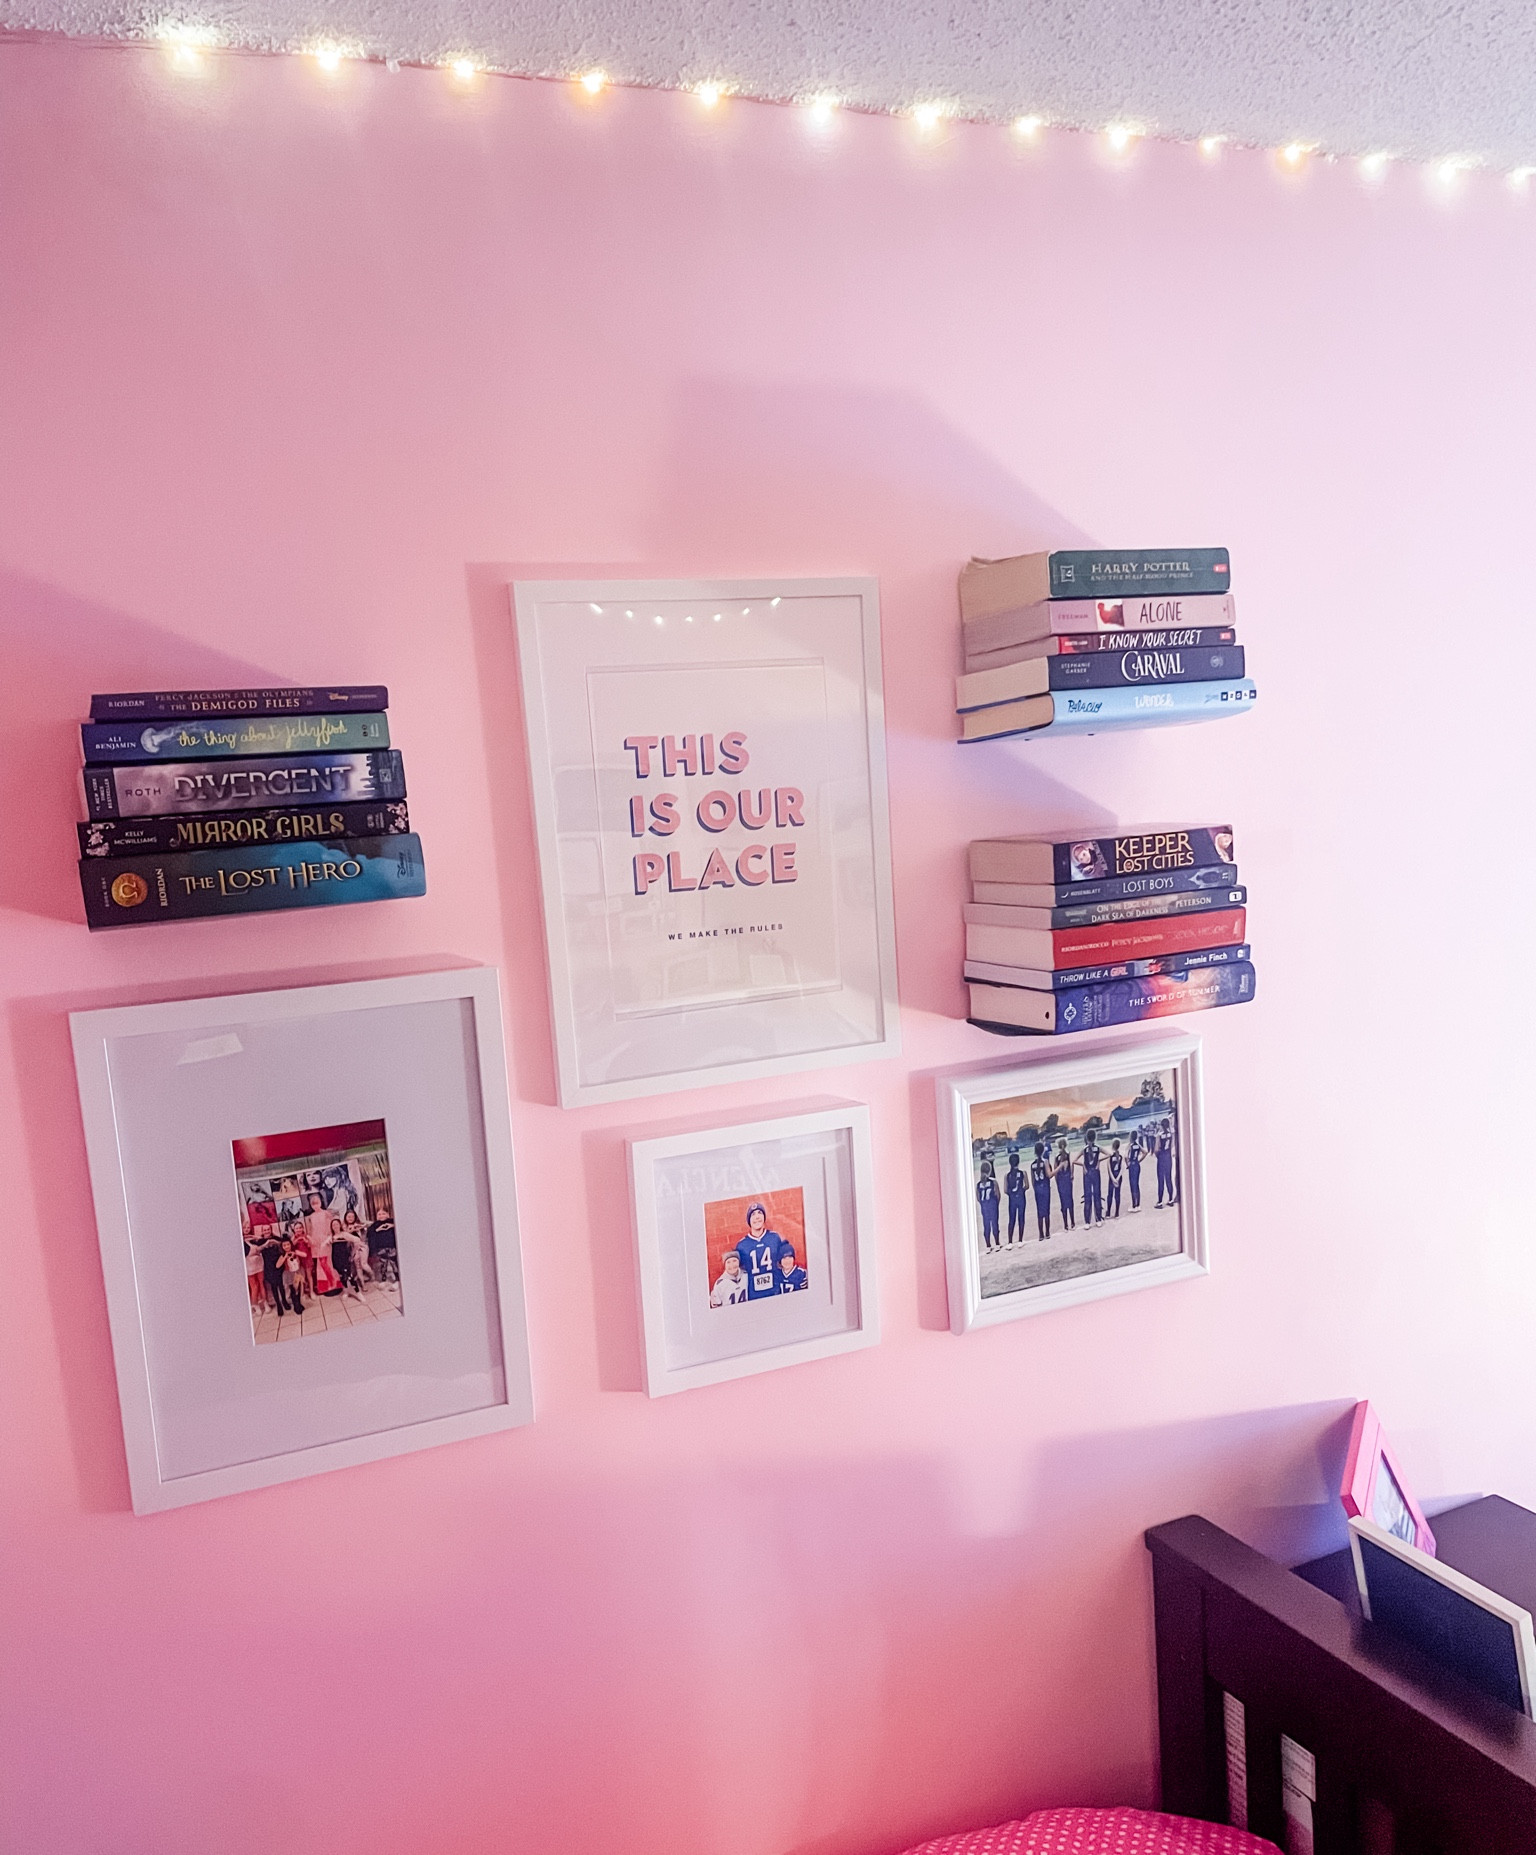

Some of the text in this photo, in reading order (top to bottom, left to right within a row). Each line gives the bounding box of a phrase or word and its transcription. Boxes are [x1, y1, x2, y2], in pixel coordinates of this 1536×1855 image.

[1092, 561, 1190, 573] HARRY POTTER
[1140, 601, 1182, 624] ALONE
[1098, 635, 1106, 650] I
[1109, 633, 1138, 650] KNOW
[1141, 632, 1166, 648] YOUR
[1167, 629, 1202, 647] SECRET
[1121, 651, 1184, 681] CARAVAL
[187, 692, 231, 700] JACKSON
[262, 689, 314, 698] OLYMPIANS
[108, 700, 145, 708] RIORDAN
[191, 699, 258, 711] DEMIGOD
[265, 698, 300, 709] FILES
[95, 742, 137, 750] BENJAMIN
[179, 730, 201, 746] the
[204, 729, 236, 749] thing
[240, 725, 279, 742] about
[623, 731, 750, 779] THIS
[173, 766, 352, 800] DIVERGENT
[125, 788, 162, 797] ROTH
[629, 787, 805, 838] IS OUR
[125, 830, 144, 838] KELLY
[276, 812, 345, 838] GIRLS
[1114, 832, 1193, 859] KEEPER
[632, 842, 799, 896] PLACE
[1116, 857, 1151, 874] LOST
[1152, 851, 1194, 870] CITIES
[155, 867, 168, 907] RIORDAN
[179, 860, 361, 896] THE LOST HERO
[1122, 876, 1174, 894] LOST BOYS
[1096, 905, 1109, 913] ON
[1175, 896, 1212, 909] PETERSON
[1091, 913, 1110, 923] DARK
[1111, 911, 1124, 920] SEA
[1135, 905, 1169, 918] DARKNESS
[668, 923, 783, 941] WE MAKE THE RULES
[1184, 952, 1228, 966] Jennie Finch
[1059, 967, 1129, 984] THROW LIKE A GIRL
[1129, 998, 1145, 1007] THE
[1146, 994, 1175, 1004] SWORD
[1176, 991, 1186, 999] OF
[749, 1246, 773, 1275] 14
